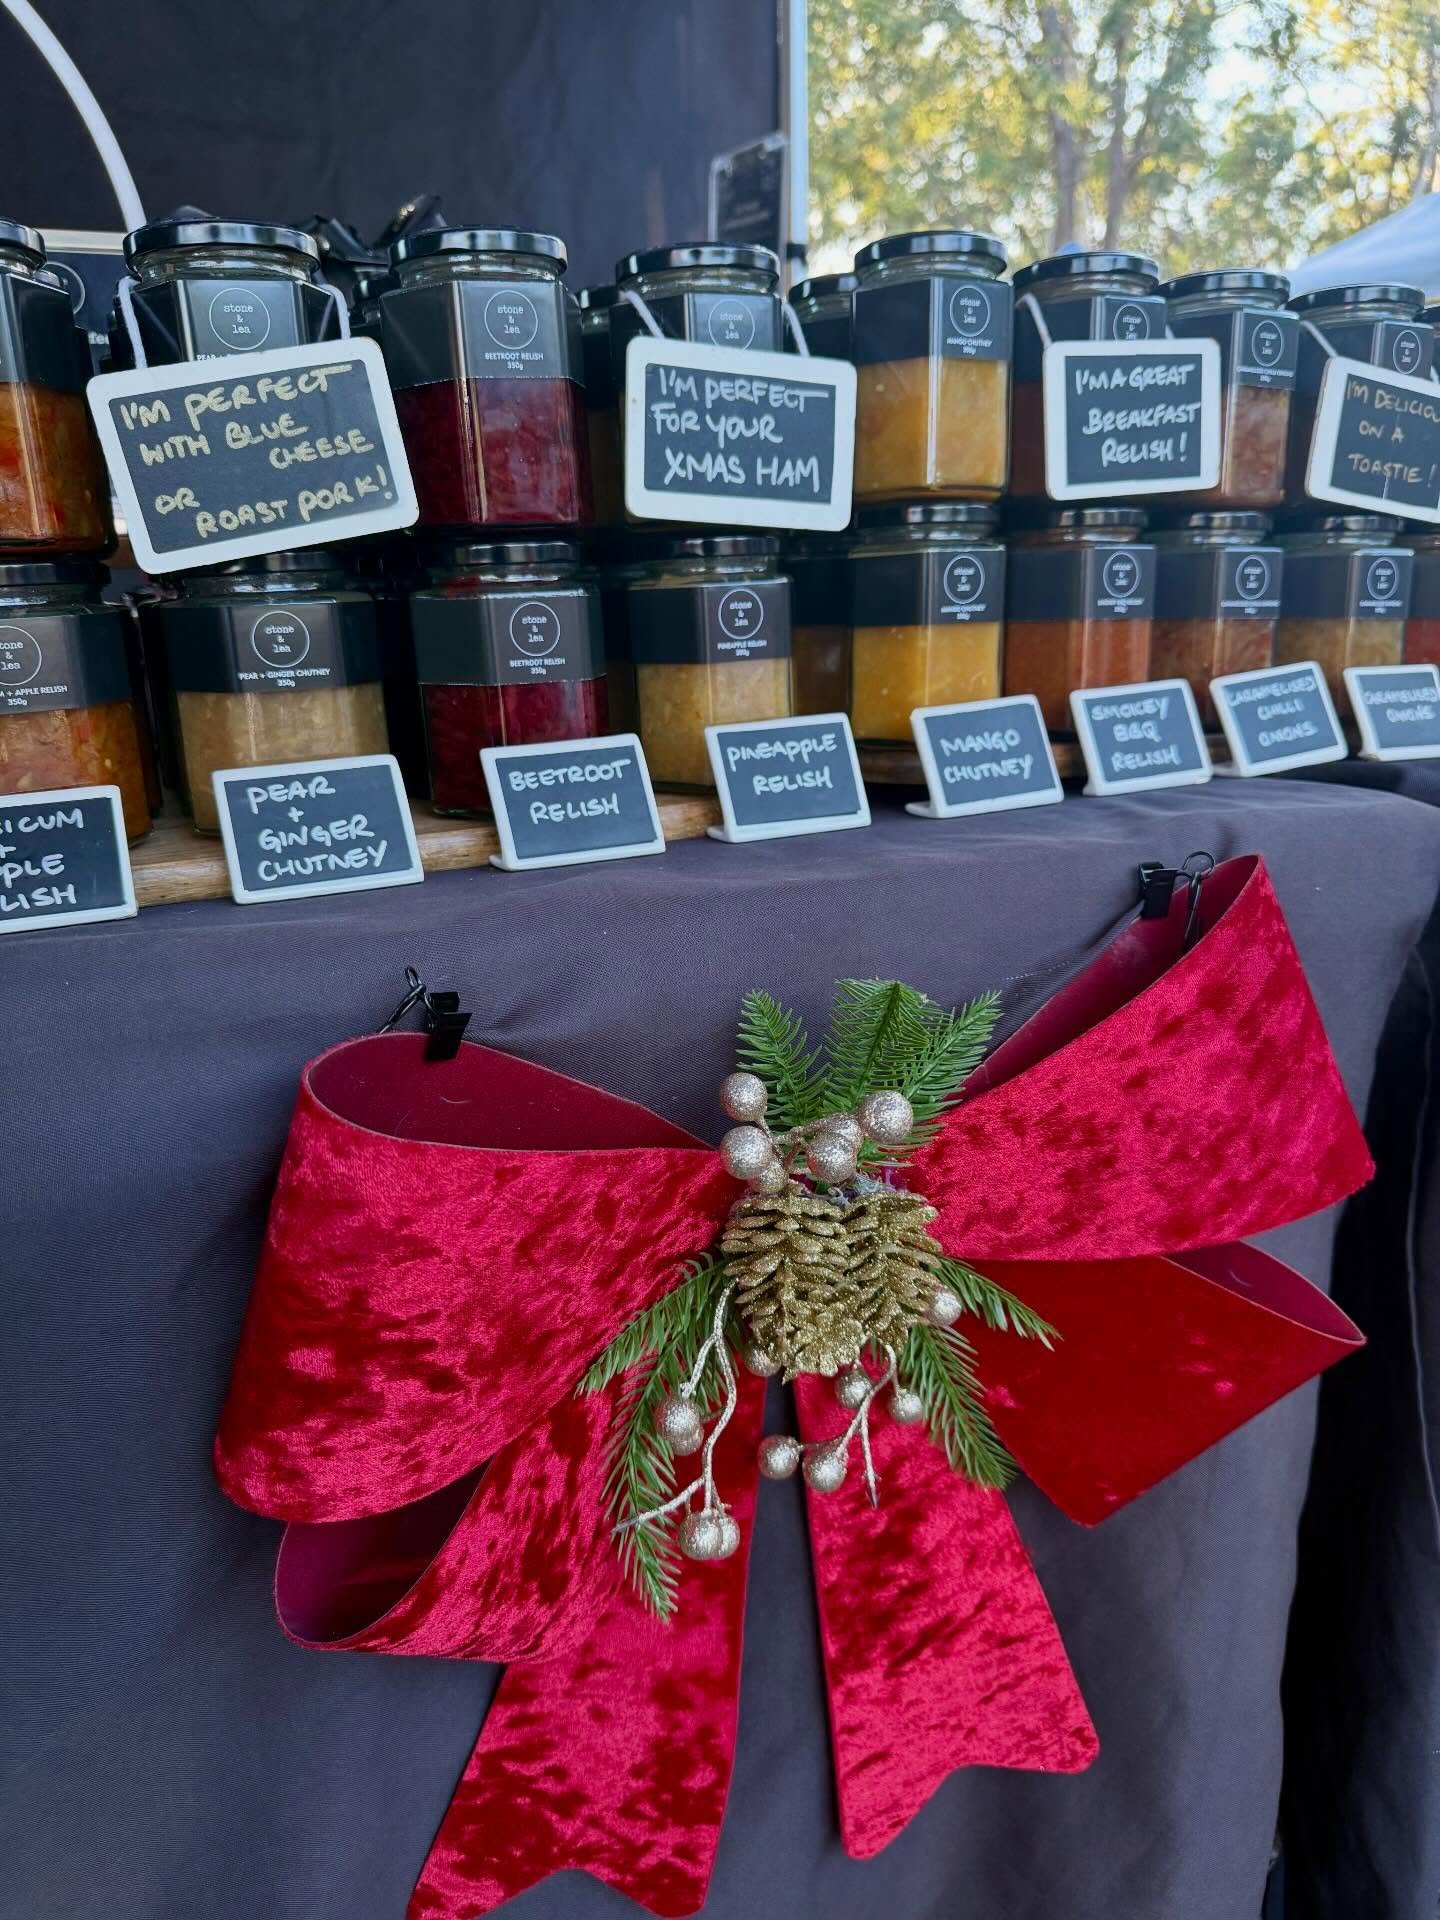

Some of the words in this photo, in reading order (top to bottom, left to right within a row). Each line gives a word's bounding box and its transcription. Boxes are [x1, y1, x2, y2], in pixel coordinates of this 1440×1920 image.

[223, 303, 254, 313] stone
[236, 314, 244, 323] &
[498, 305, 524, 315] stone
[719, 312, 743, 322] stone
[232, 324, 252, 334] lea
[504, 325, 520, 334] lea
[508, 316, 514, 324] &
[725, 330, 740, 339] lea
[485, 352, 520, 360] BEETROOT
[659, 367, 698, 401] I'M
[704, 378, 829, 413] PERFECT
[1075, 369, 1109, 396] I'M
[1129, 364, 1196, 392] GREAT
[1347, 380, 1368, 403] I'M
[120, 400, 171, 430] I'M
[184, 364, 352, 431] PERFECT
[650, 403, 700, 435] FOR
[705, 413, 783, 449] YOUR
[1082, 401, 1201, 435] BREAKFAST
[139, 434, 212, 466] WITH
[225, 413, 309, 449] BLUE
[1359, 420, 1385, 438] ON
[1391, 426, 1404, 444] A
[268, 428, 375, 470] CHEESE
[664, 447, 746, 486] XMAS
[756, 455, 820, 493] HAM
[154, 487, 200, 515] OR
[195, 499, 289, 538] ROAST
[298, 464, 393, 522] PORK!
[265, 625, 295, 634] stone
[522, 616, 547, 624] stone
[532, 625, 539, 633] &
[272, 644, 291, 653] lea
[277, 635, 285, 643] &
[528, 633, 544, 643] lea
[1, 662, 21, 670] lea
[5, 651, 13, 660] &
[509, 659, 543, 668] BEETROOT
[544, 658, 566, 666] RELISH
[238, 672, 259, 681] PEAR
[267, 670, 295, 679] GINGER
[296, 668, 331, 677] CHUTNEY
[277, 679, 296, 688] 350g
[7, 698, 28, 706] 350g
[15, 687, 40, 696] APPLE
[40, 685, 68, 694] RELISH
[1090, 696, 1169, 721] SMOKEY
[727, 733, 837, 771] PINEAPPLE
[939, 728, 1020, 757] MANGO
[943, 753, 1034, 783] CHUTNEY
[1111, 744, 1182, 772] RELISH
[508, 758, 631, 792] BEETROOT
[752, 766, 834, 796] RELISH
[246, 775, 336, 815] PEAR
[287, 806, 305, 823] +
[529, 793, 621, 825] RELISH
[0, 808, 84, 834] ICUM
[258, 814, 376, 854] GINGER
[0, 853, 65, 889] PLE
[258, 839, 388, 883] CHUTNEY
